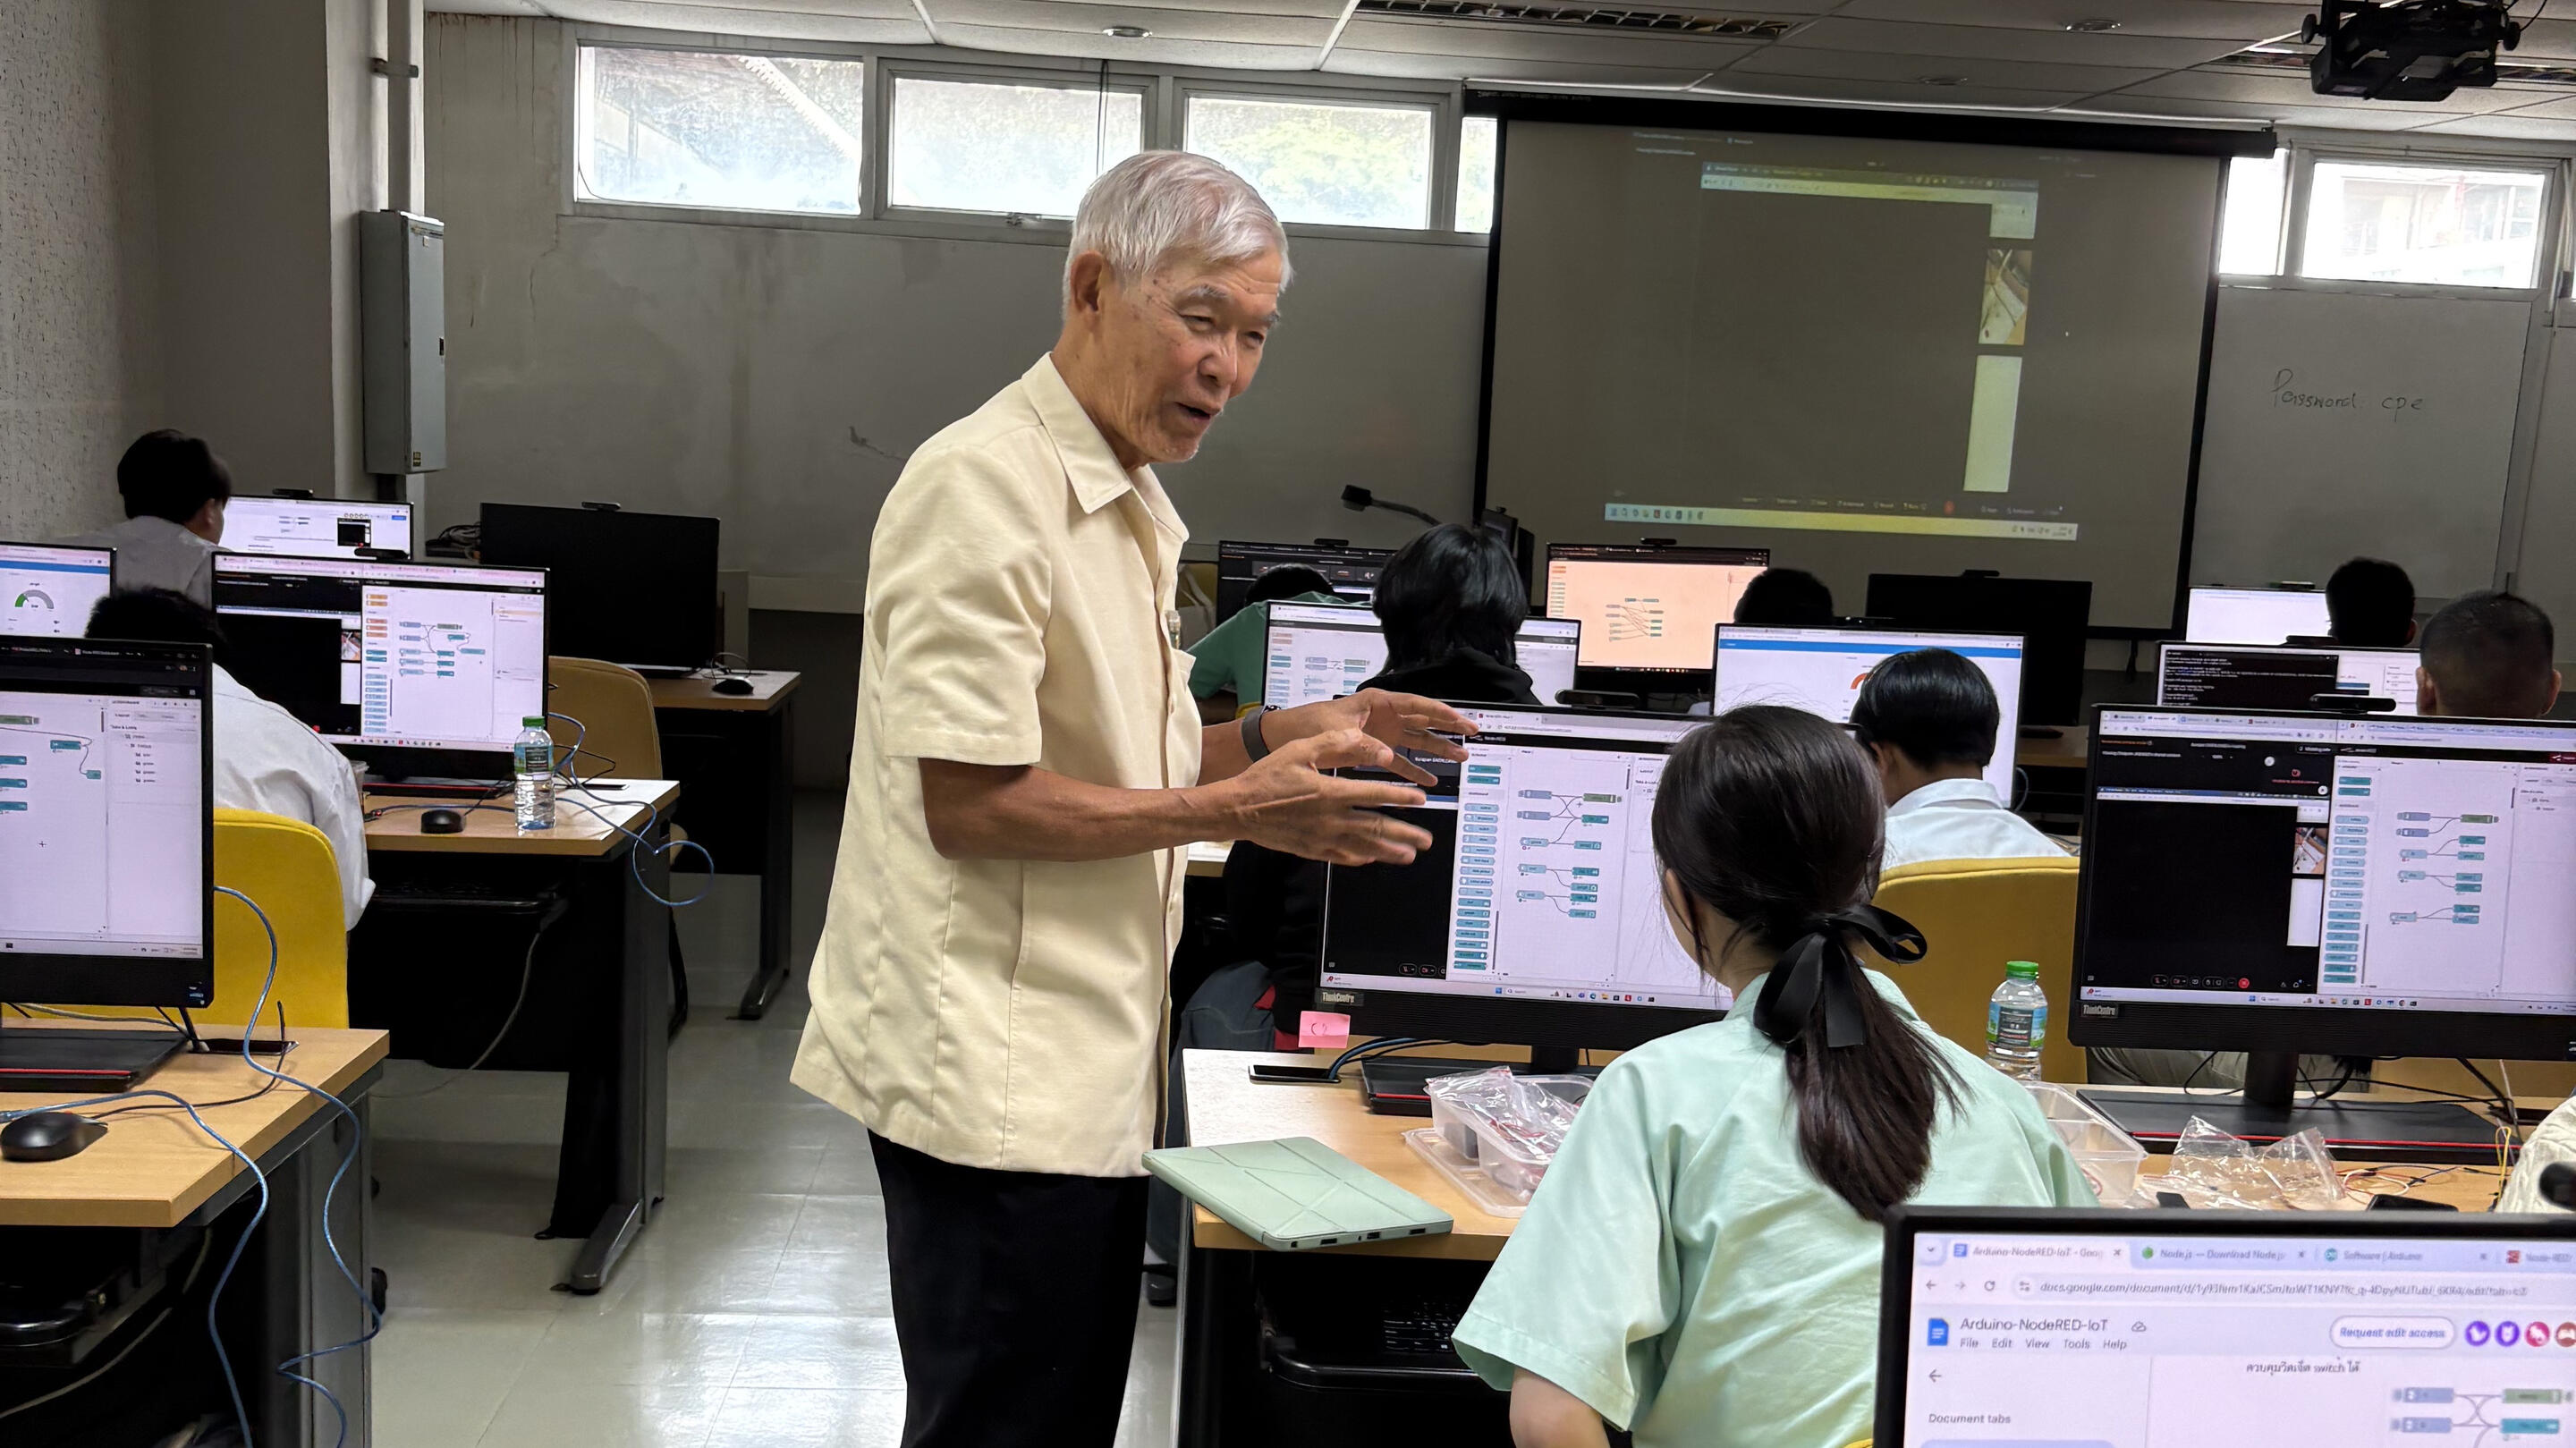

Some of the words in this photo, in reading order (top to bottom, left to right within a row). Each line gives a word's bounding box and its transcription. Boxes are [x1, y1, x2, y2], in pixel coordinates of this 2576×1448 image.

[1960, 1318, 2108, 1332] Arduino-NodeRED-IoT
[2340, 1327, 2384, 1339] Request
[2385, 1327, 2406, 1338] edit
[2409, 1329, 2445, 1338] access
[1960, 1338, 1979, 1349] File
[1992, 1338, 2012, 1349] Edit
[2026, 1338, 2050, 1349] View
[2063, 1339, 2090, 1350] Tools
[2103, 1339, 2127, 1351] Help
[1928, 1413, 1985, 1424] Document
[1987, 1413, 2011, 1424] tabs
